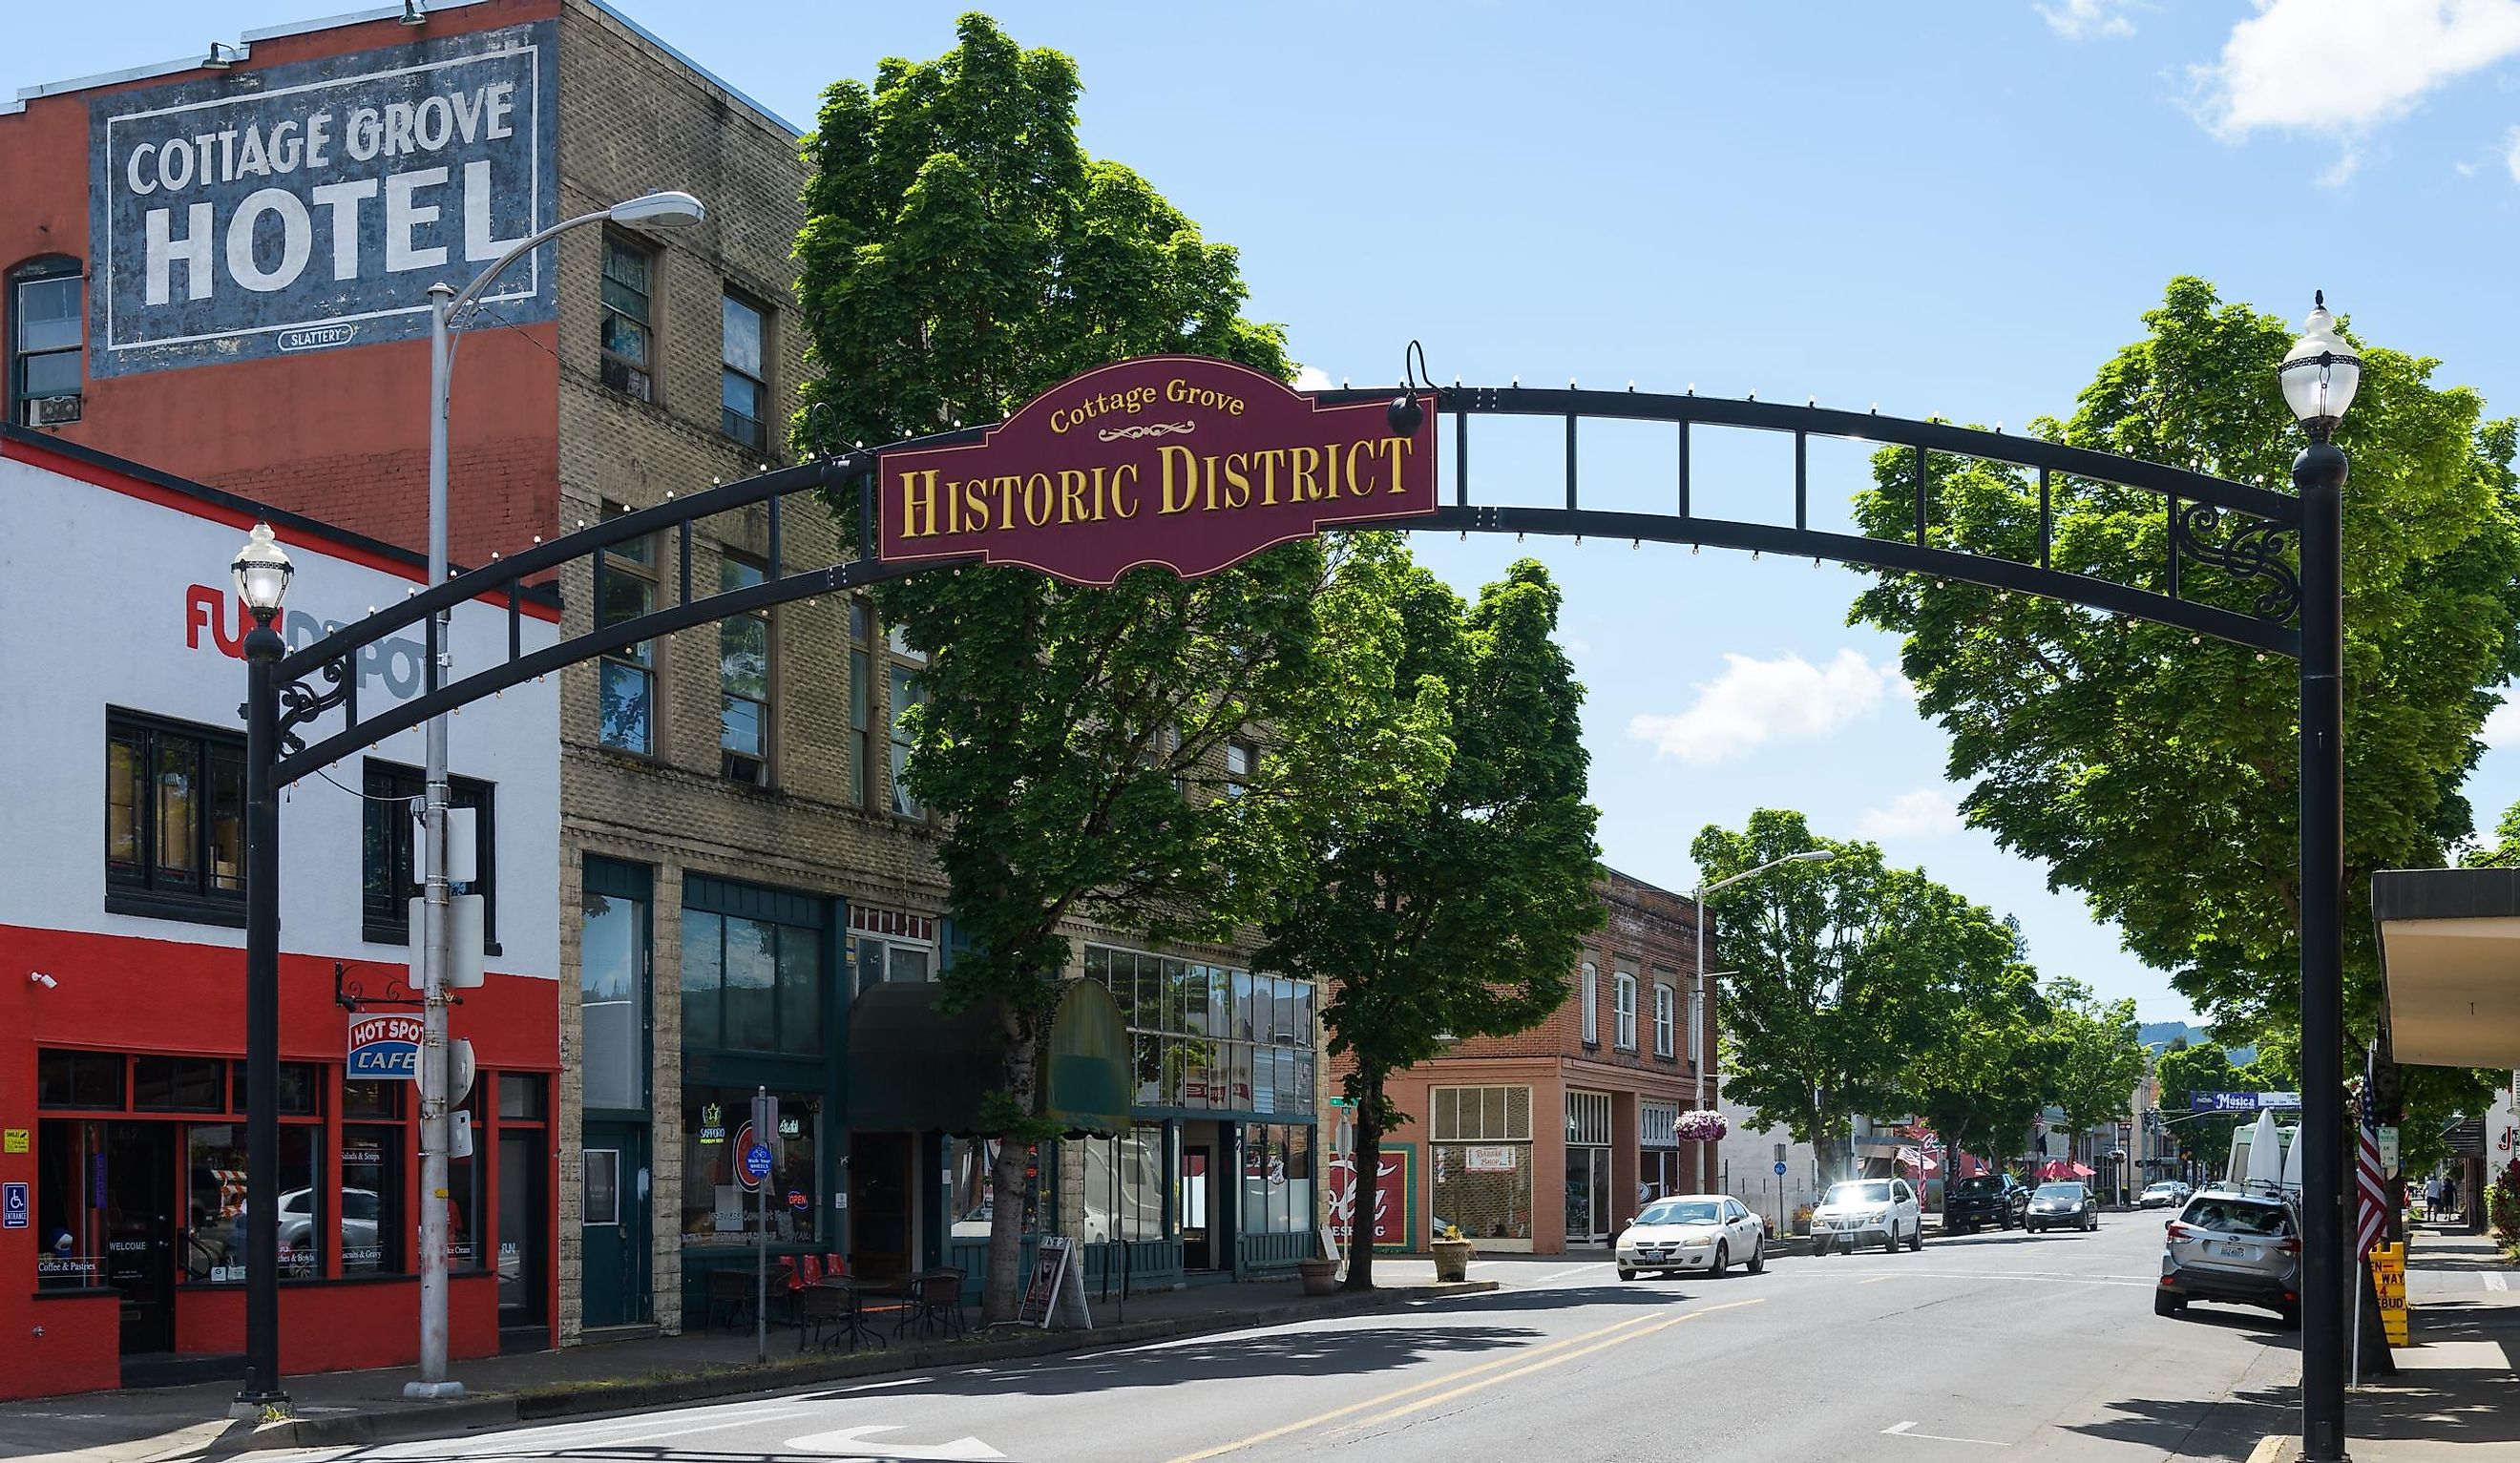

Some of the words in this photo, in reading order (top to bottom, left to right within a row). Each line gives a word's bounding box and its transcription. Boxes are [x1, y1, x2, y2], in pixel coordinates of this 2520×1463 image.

[127, 114, 330, 196] COTTAGE
[346, 81, 514, 162] GROVE
[145, 159, 532, 305] HOTEL
[290, 328, 343, 347] SLATTERY
[1049, 385, 1157, 435] Cottage
[1166, 378, 1246, 417] Grove
[899, 462, 1141, 539] HISTORIC
[1156, 434, 1415, 516] DISTRICT
[354, 1020, 387, 1046] HOT
[388, 1019, 424, 1042] SPO
[357, 1052, 416, 1069] CAFE
[788, 1195, 807, 1204] OPEN
[5, 1212, 27, 1221] ENTRANCE
[109, 1241, 146, 1250] WELCOME
[38, 1262, 60, 1271] Coffee
[62, 1262, 69, 1271] &
[71, 1262, 95, 1271] Pastries
[2382, 1274, 2404, 1284] WAY
[2380, 1285, 2387, 1297] 4
